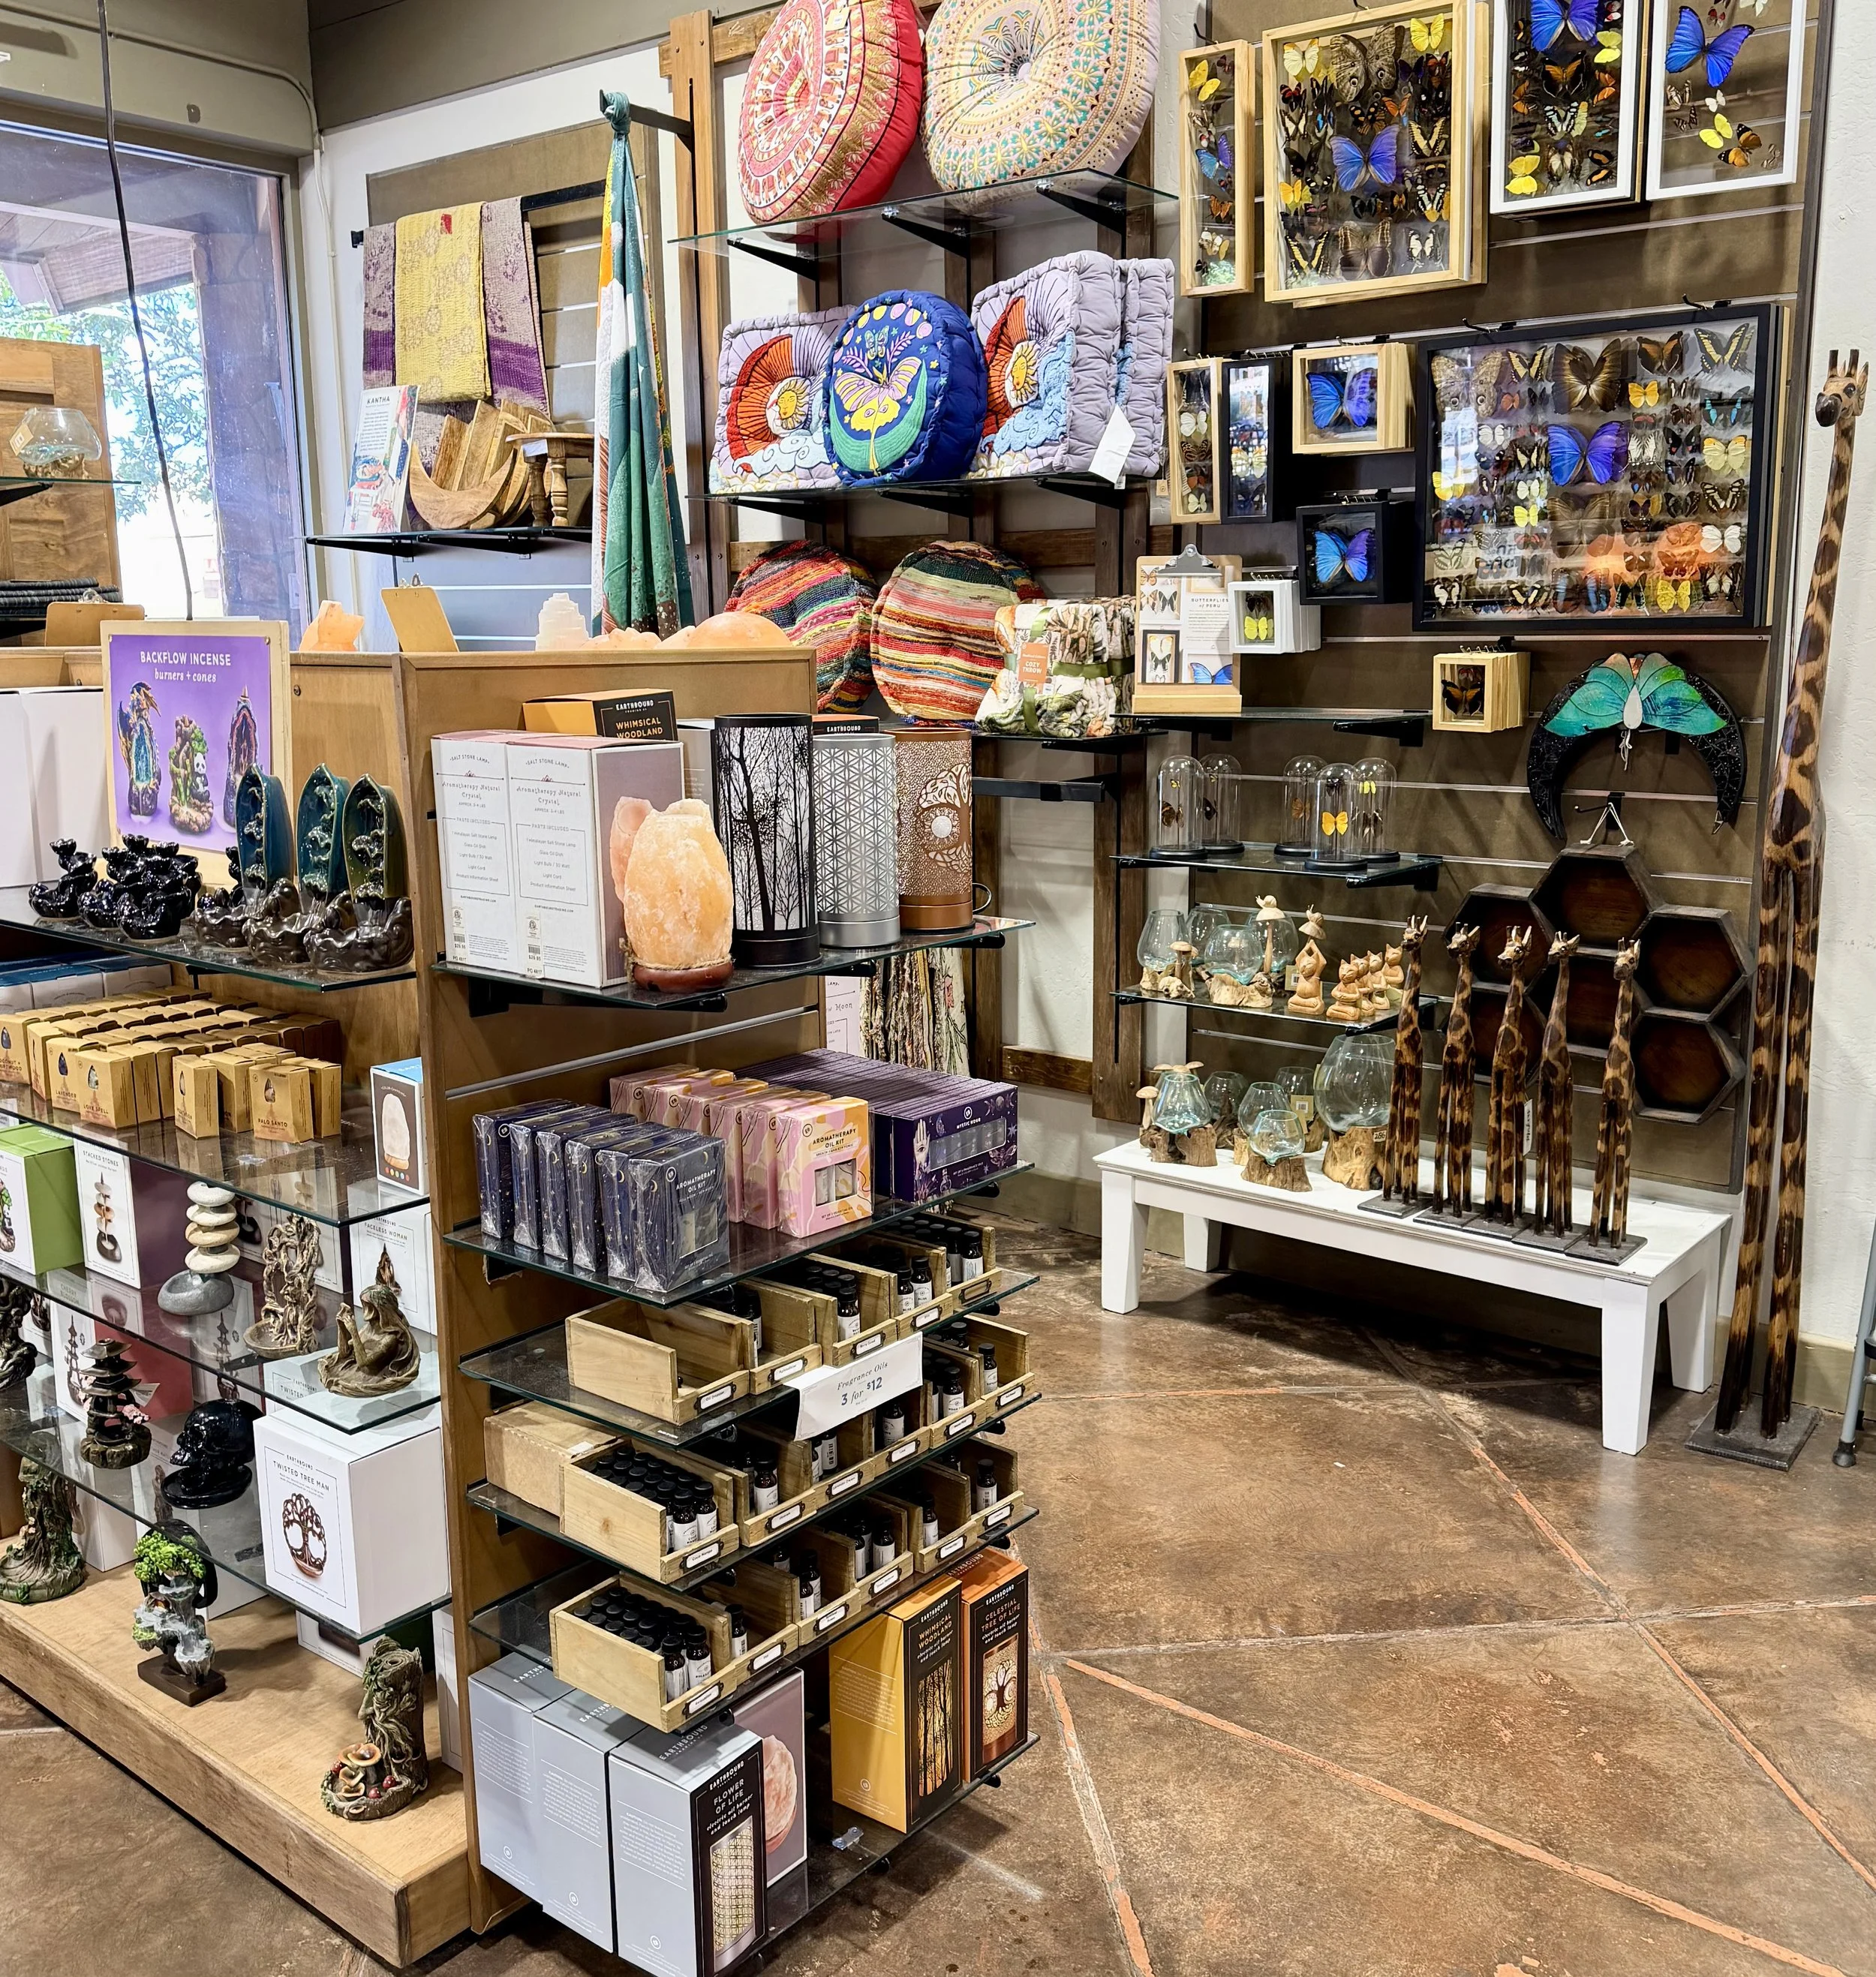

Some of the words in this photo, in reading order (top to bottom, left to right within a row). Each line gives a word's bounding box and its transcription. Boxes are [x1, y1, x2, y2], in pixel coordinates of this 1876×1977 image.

[367, 396, 389, 404] KANTHA
[140, 651, 187, 664] BACKFLOW
[190, 653, 231, 666] INCENSE
[155, 669, 184, 681] burners
[193, 672, 216, 683] cones
[615, 699, 654, 711] EARTHBOUND
[616, 717, 660, 730] WHIMSICAL
[616, 727, 663, 739] WOODLAND
[442, 782, 479, 791] Aromatherapy
[516, 786, 556, 796] Aromatherapy
[538, 798, 560, 806] Crystal
[835, 1003, 852, 1011] Moon
[56, 1089, 77, 1098] LAVENDER
[813, 1128, 856, 1144] AROMATHERAPY
[83, 1150, 101, 1161] STACKED
[102, 1156, 119, 1167] STONES
[676, 1169, 716, 1190] AROMATHERAPY
[364, 1222, 387, 1234] FACELESS
[389, 1230, 407, 1240] WOMAN
[837, 1369, 873, 1390] Fragrance
[874, 1361, 888, 1372] Oils
[280, 1385, 304, 1398] TWISTED
[841, 1393, 848, 1406] 3
[850, 1390, 863, 1404] for
[867, 1377, 882, 1391] $12
[287, 1455, 313, 1470] EARTHBOUND
[273, 1460, 298, 1477] TWISTED
[300, 1473, 314, 1485] TREE
[316, 1480, 329, 1492] MAN
[947, 1554, 984, 1576] ARTHBOUND
[986, 1585, 1015, 1606] EARTHBOUND
[921, 1599, 949, 1623] EARTHBOUND
[981, 1621, 997, 1633] TREE
[1009, 1603, 1021, 1615] LIFE
[985, 1598, 1017, 1621] CELESTIAL
[918, 1613, 952, 1640] WHIMSICAL
[918, 1621, 952, 1650] WOODLAND
[982, 1628, 998, 1640] electric
[1006, 1614, 1021, 1626] burner
[994, 1629, 1006, 1639] touch
[1007, 1621, 1018, 1631] lamp
[917, 1645, 933, 1660] electric
[940, 1630, 953, 1644] burner
[920, 1655, 928, 1663] and
[929, 1647, 941, 1657] touch
[941, 1638, 951, 1648] lamp
[659, 1724, 708, 1760] EARTHBOUND
[709, 1760, 744, 1790] EARTHBOUND
[714, 1778, 744, 1806] FLOWER
[715, 1802, 726, 1814] OF
[728, 1789, 744, 1806] LIFE
[706, 1813, 726, 1831] electric
[736, 1793, 753, 1809] burner
[711, 1823, 720, 1835] and
[722, 1813, 736, 1827] touch
[738, 1803, 750, 1815] lamp
